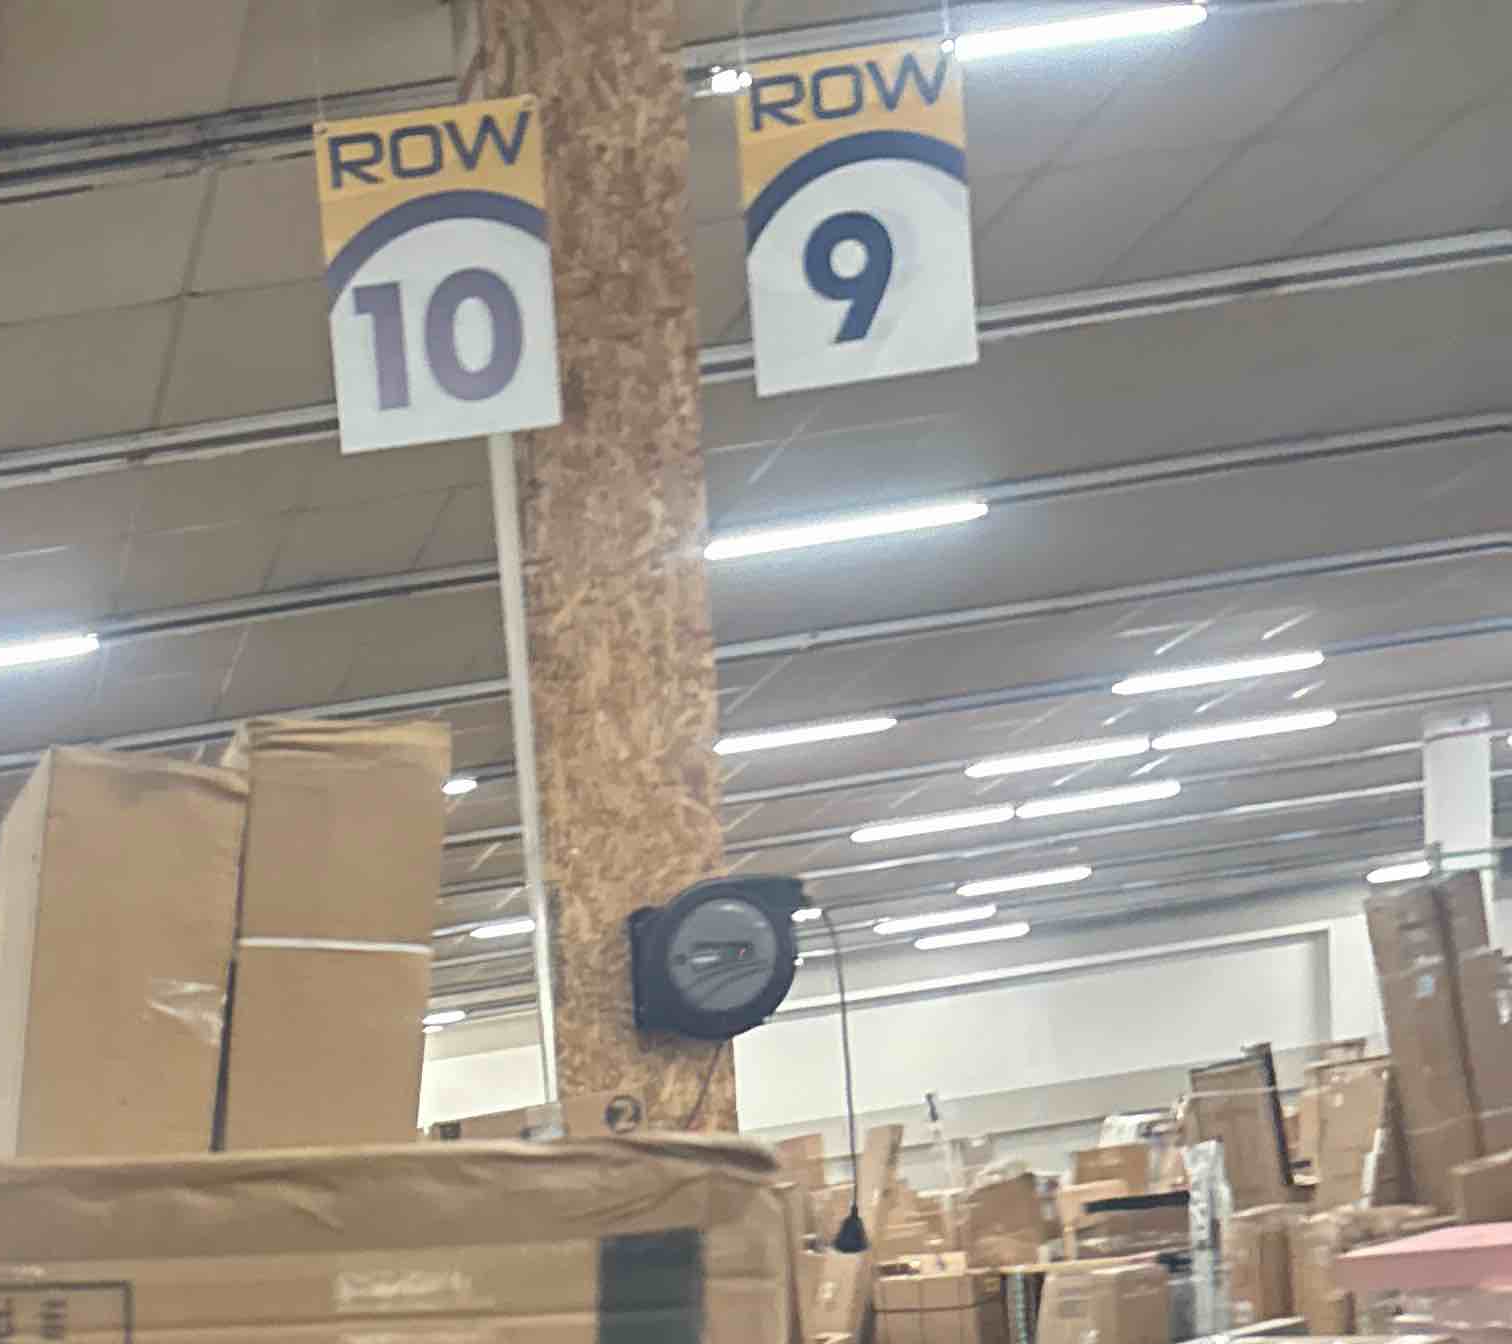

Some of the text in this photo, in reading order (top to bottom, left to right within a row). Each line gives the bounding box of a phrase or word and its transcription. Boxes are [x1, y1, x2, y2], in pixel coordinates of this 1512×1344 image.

[748, 52, 949, 133] ROW
[328, 110, 533, 189] ROW
[804, 211, 893, 345] 9
[352, 267, 523, 411] 10
